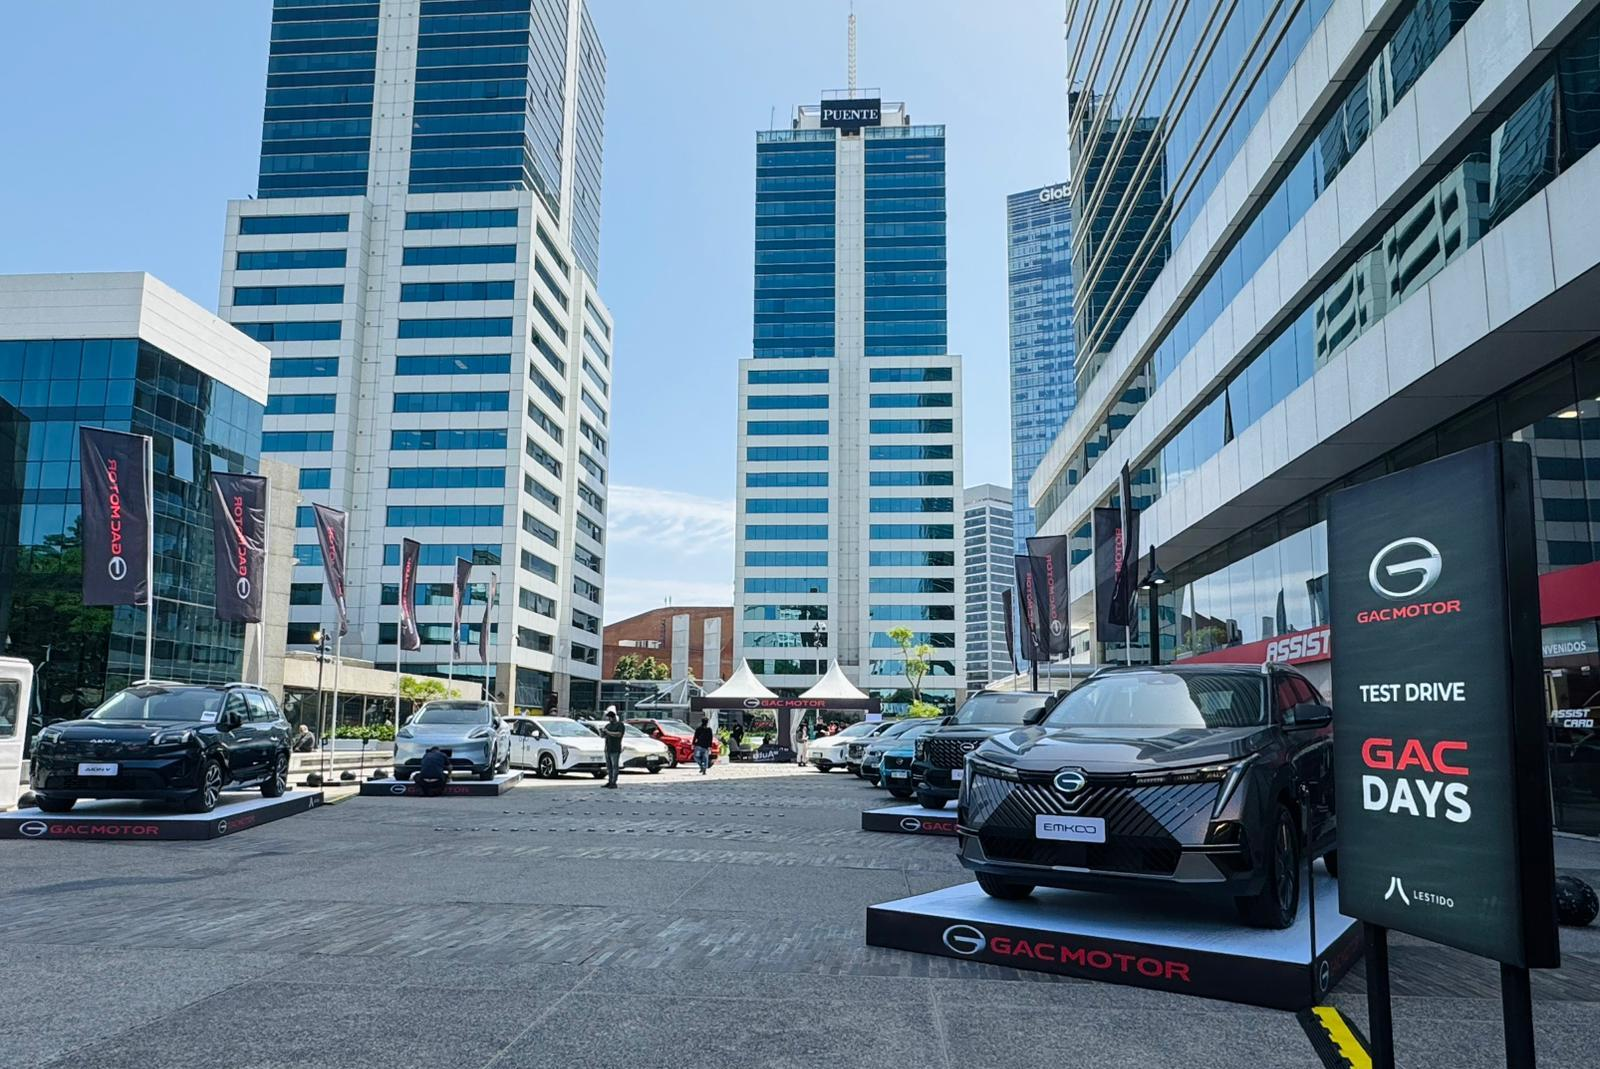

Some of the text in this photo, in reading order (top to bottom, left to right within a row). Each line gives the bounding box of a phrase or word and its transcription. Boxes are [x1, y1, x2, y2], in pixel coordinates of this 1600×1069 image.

[823, 109, 878, 120] PUENTE
[1267, 629, 1330, 663] ASSIST
[1360, 682, 1466, 703] TEST DRIVE
[1551, 708, 1590, 718] ASSIST
[1563, 719, 1594, 728] CARD
[1361, 737, 1470, 775] GAC
[1362, 775, 1472, 823] DAYS
[922, 821, 952, 831] GAC
[1413, 890, 1455, 908] LESTIDO
